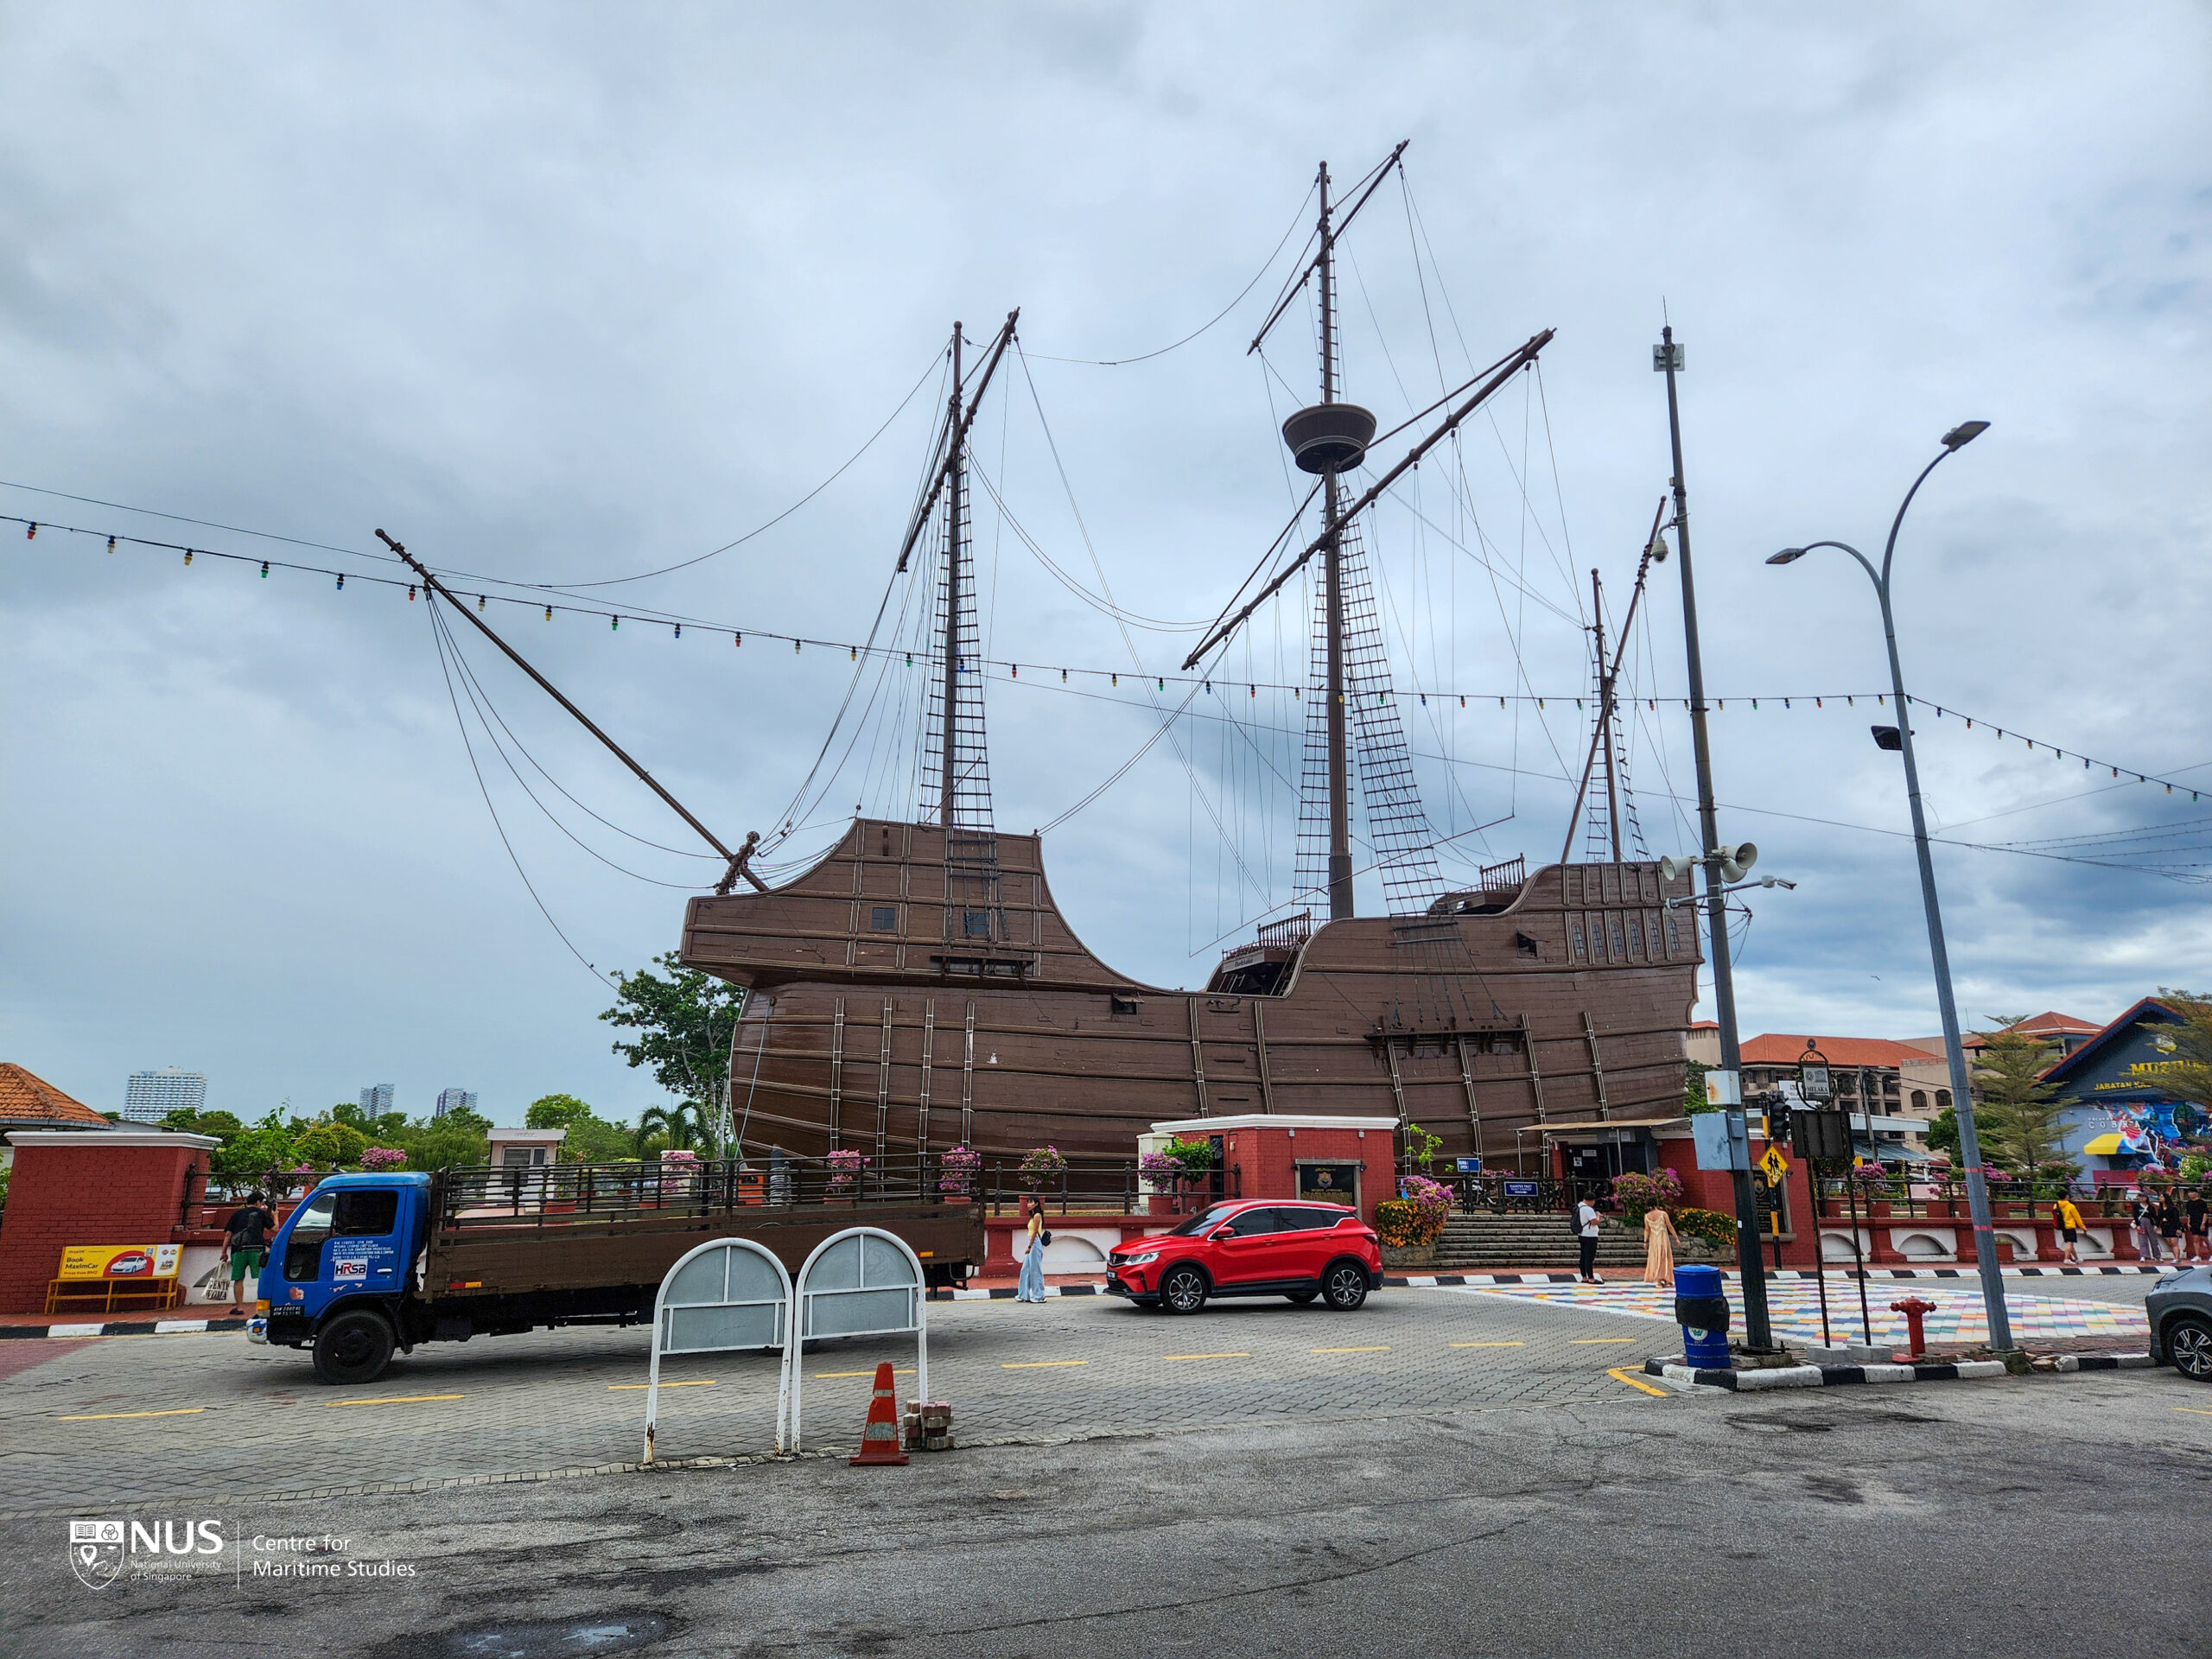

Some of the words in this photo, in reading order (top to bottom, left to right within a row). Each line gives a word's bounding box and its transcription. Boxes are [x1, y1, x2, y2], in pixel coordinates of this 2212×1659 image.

[2094, 1081, 2133, 1091] JABATAN
[2088, 1120, 2141, 1129] COBRA
[335, 1262, 366, 1274] HRSB
